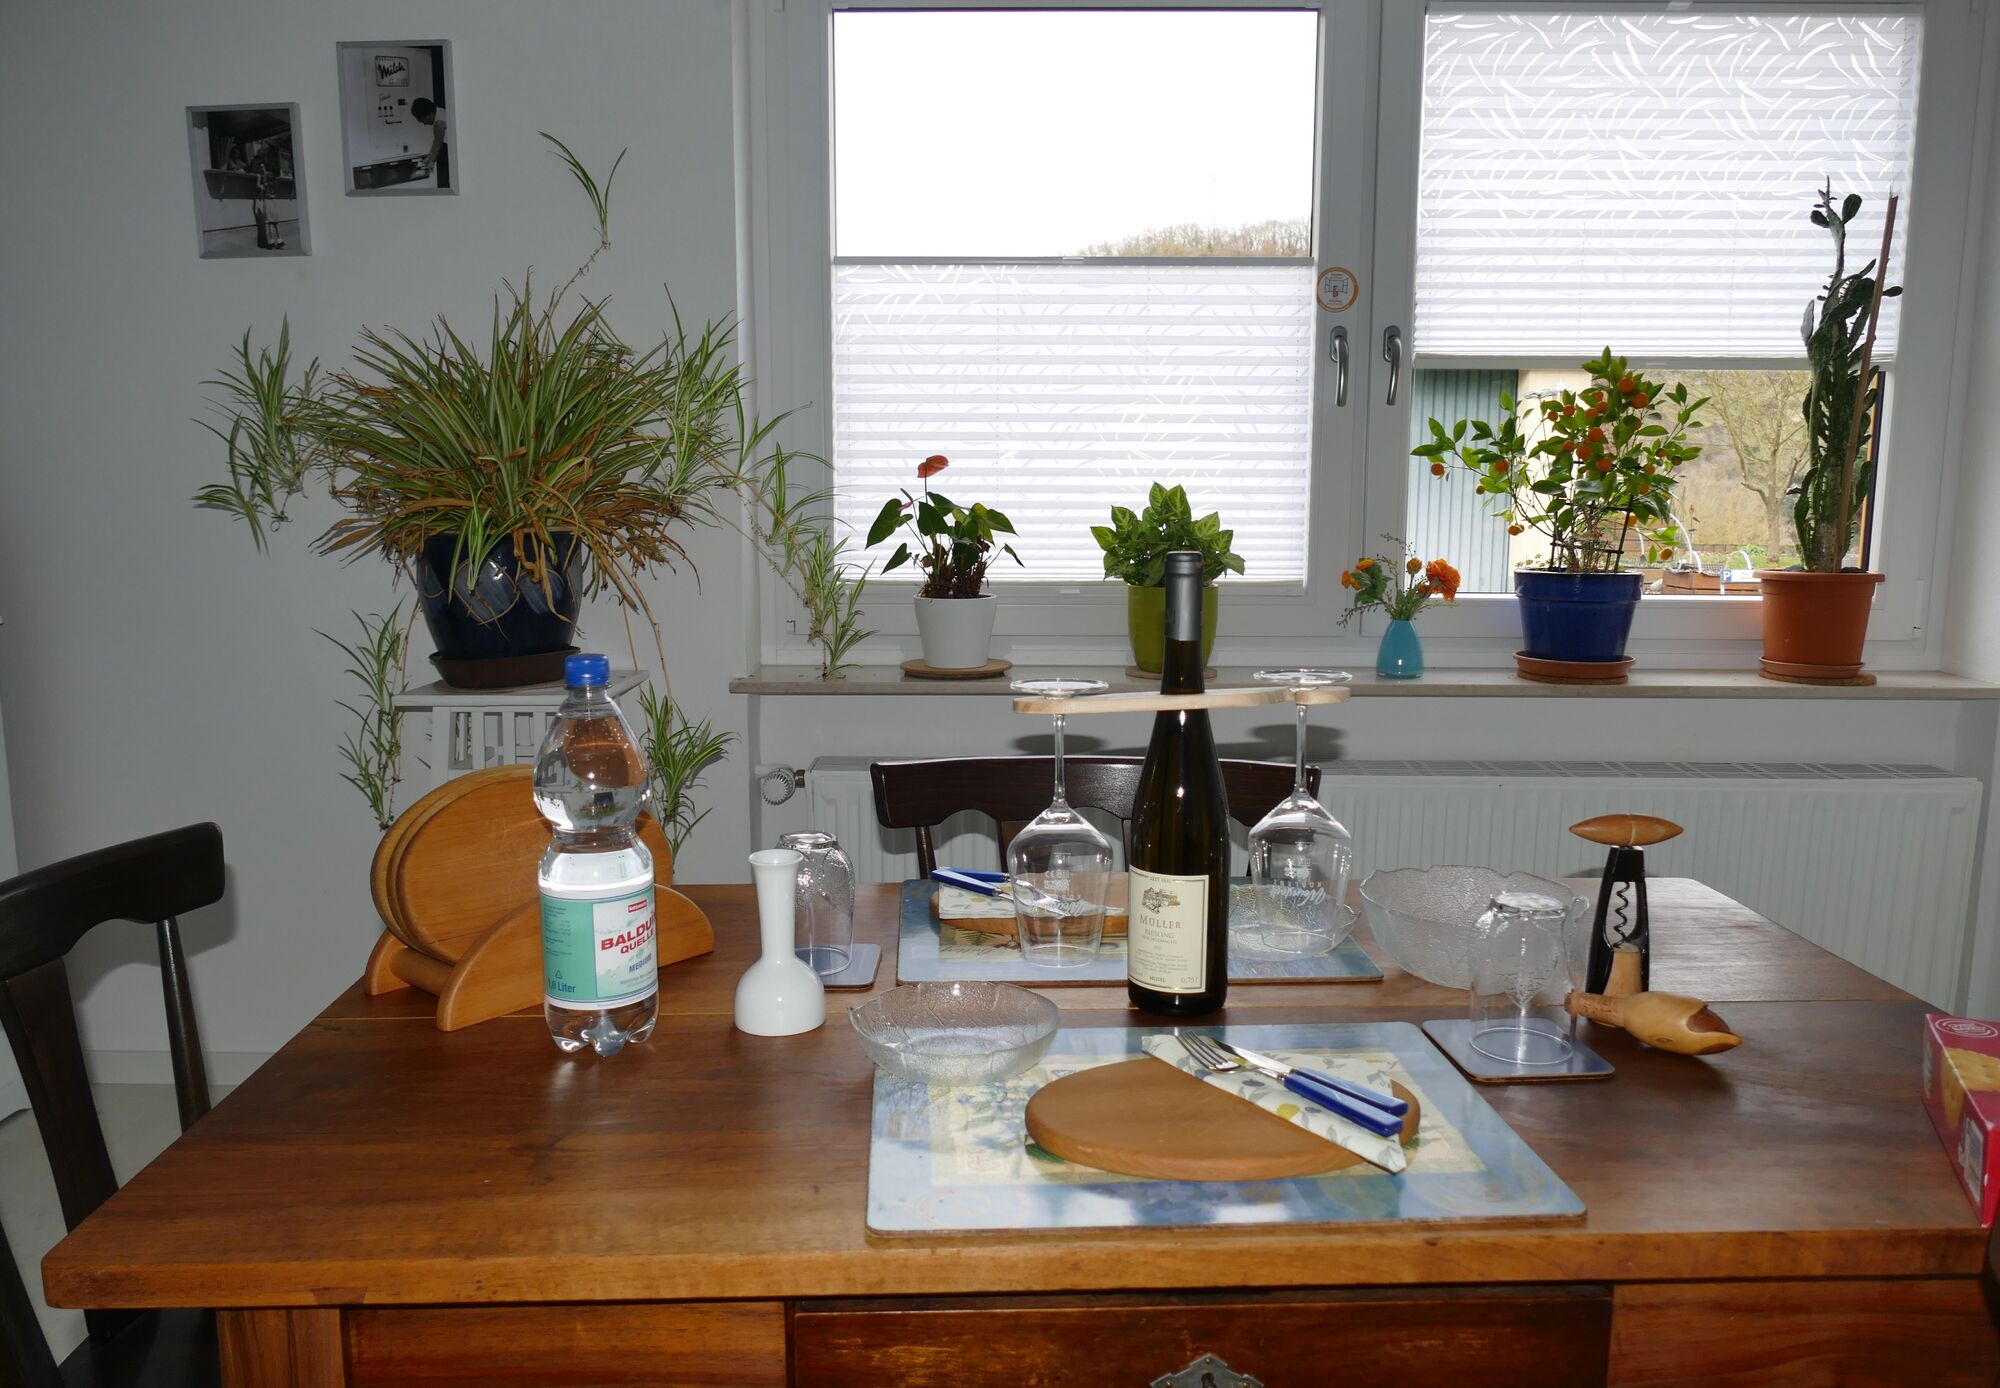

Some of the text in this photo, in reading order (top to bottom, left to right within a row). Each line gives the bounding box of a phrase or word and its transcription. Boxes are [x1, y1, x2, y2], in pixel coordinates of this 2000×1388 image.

[377, 62, 406, 80] Milch
[1723, 571, 1730, 581] P
[620, 927, 655, 955] QUELLE
[557, 981, 576, 993] Liter
